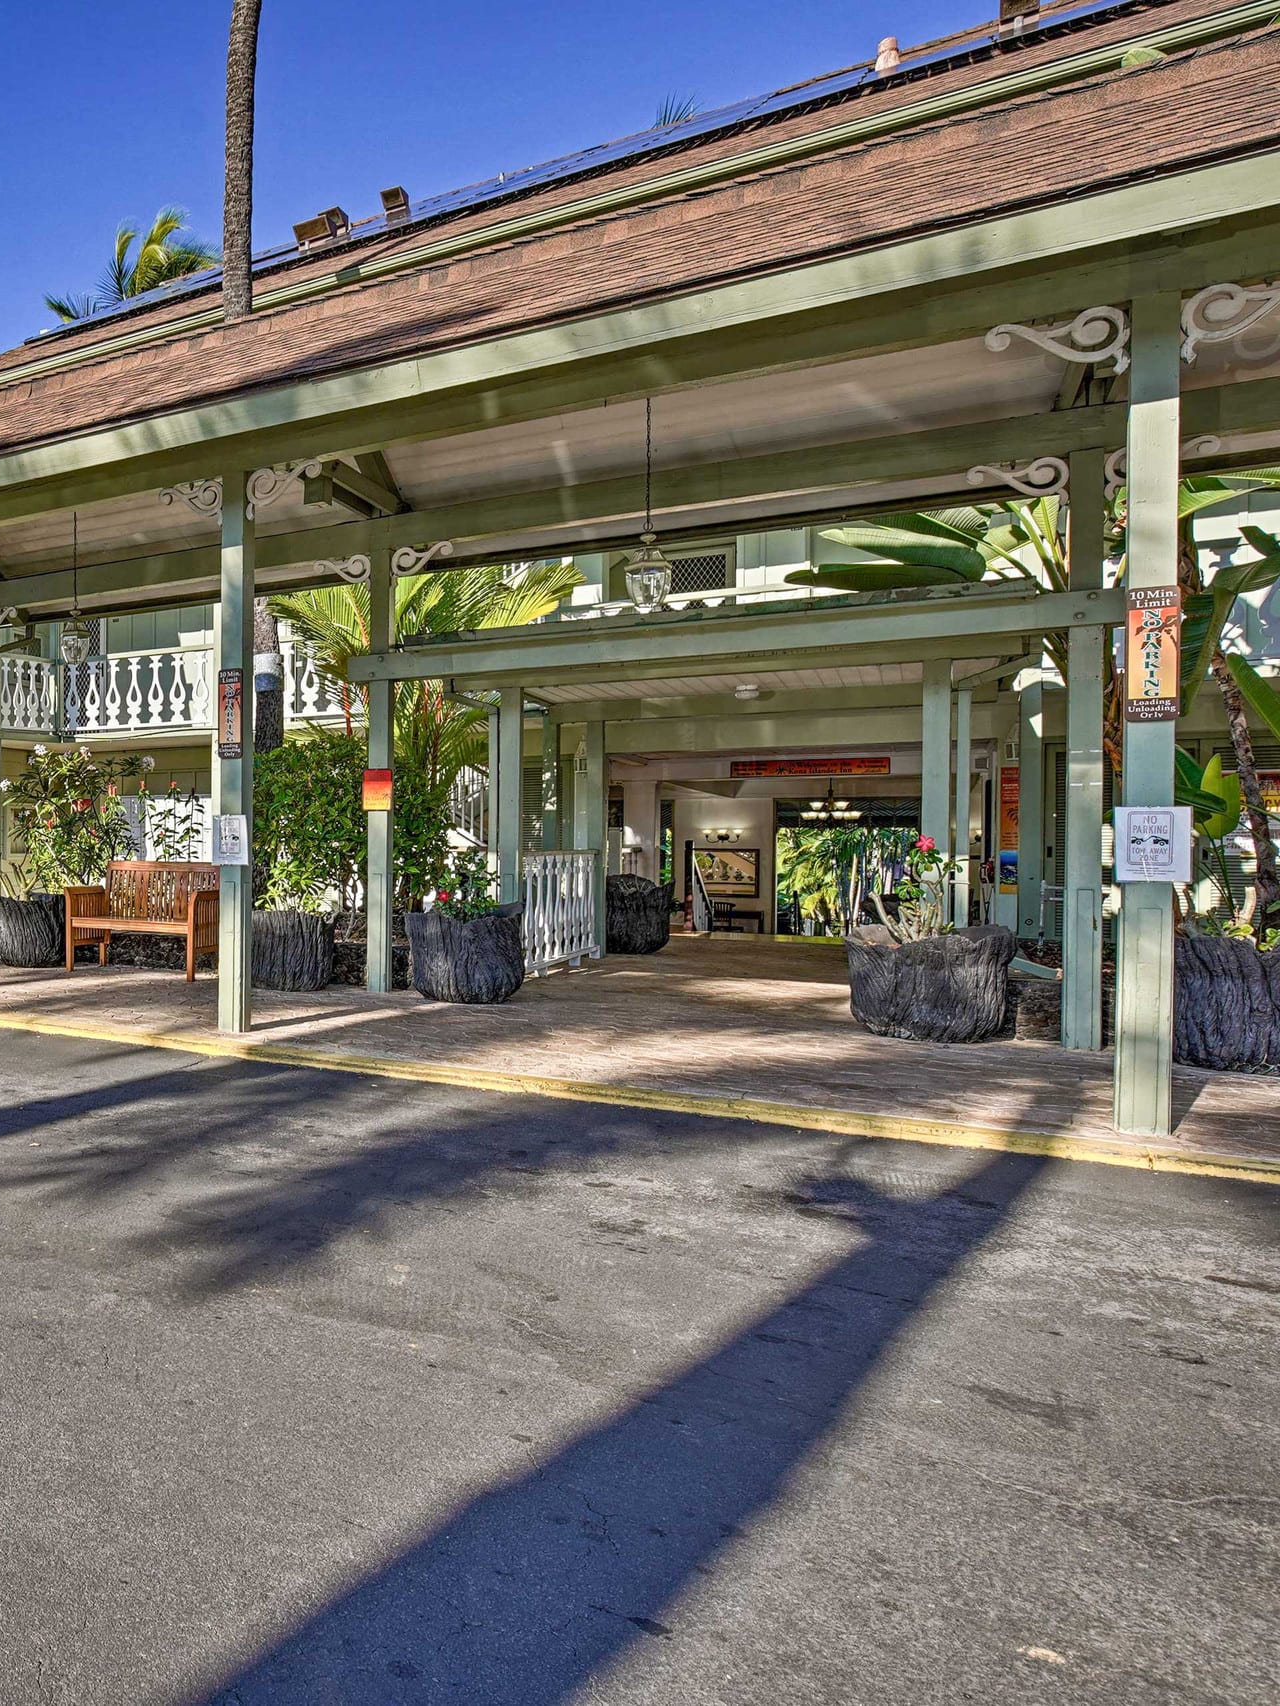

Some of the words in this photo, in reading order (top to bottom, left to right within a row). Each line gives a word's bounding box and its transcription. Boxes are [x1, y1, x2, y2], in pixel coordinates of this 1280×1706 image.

[1130, 591, 1144, 600] 10
[1147, 590, 1177, 599] Min.
[1136, 598, 1171, 608] Limit
[1143, 609, 1163, 628] NO
[1143, 631, 1162, 697] PARKING
[224, 684, 235, 697] NO
[1128, 704, 1177, 713] Unloading
[225, 698, 235, 742] PARKING
[1144, 816, 1158, 824] NO
[1132, 825, 1168, 834] PARKING
